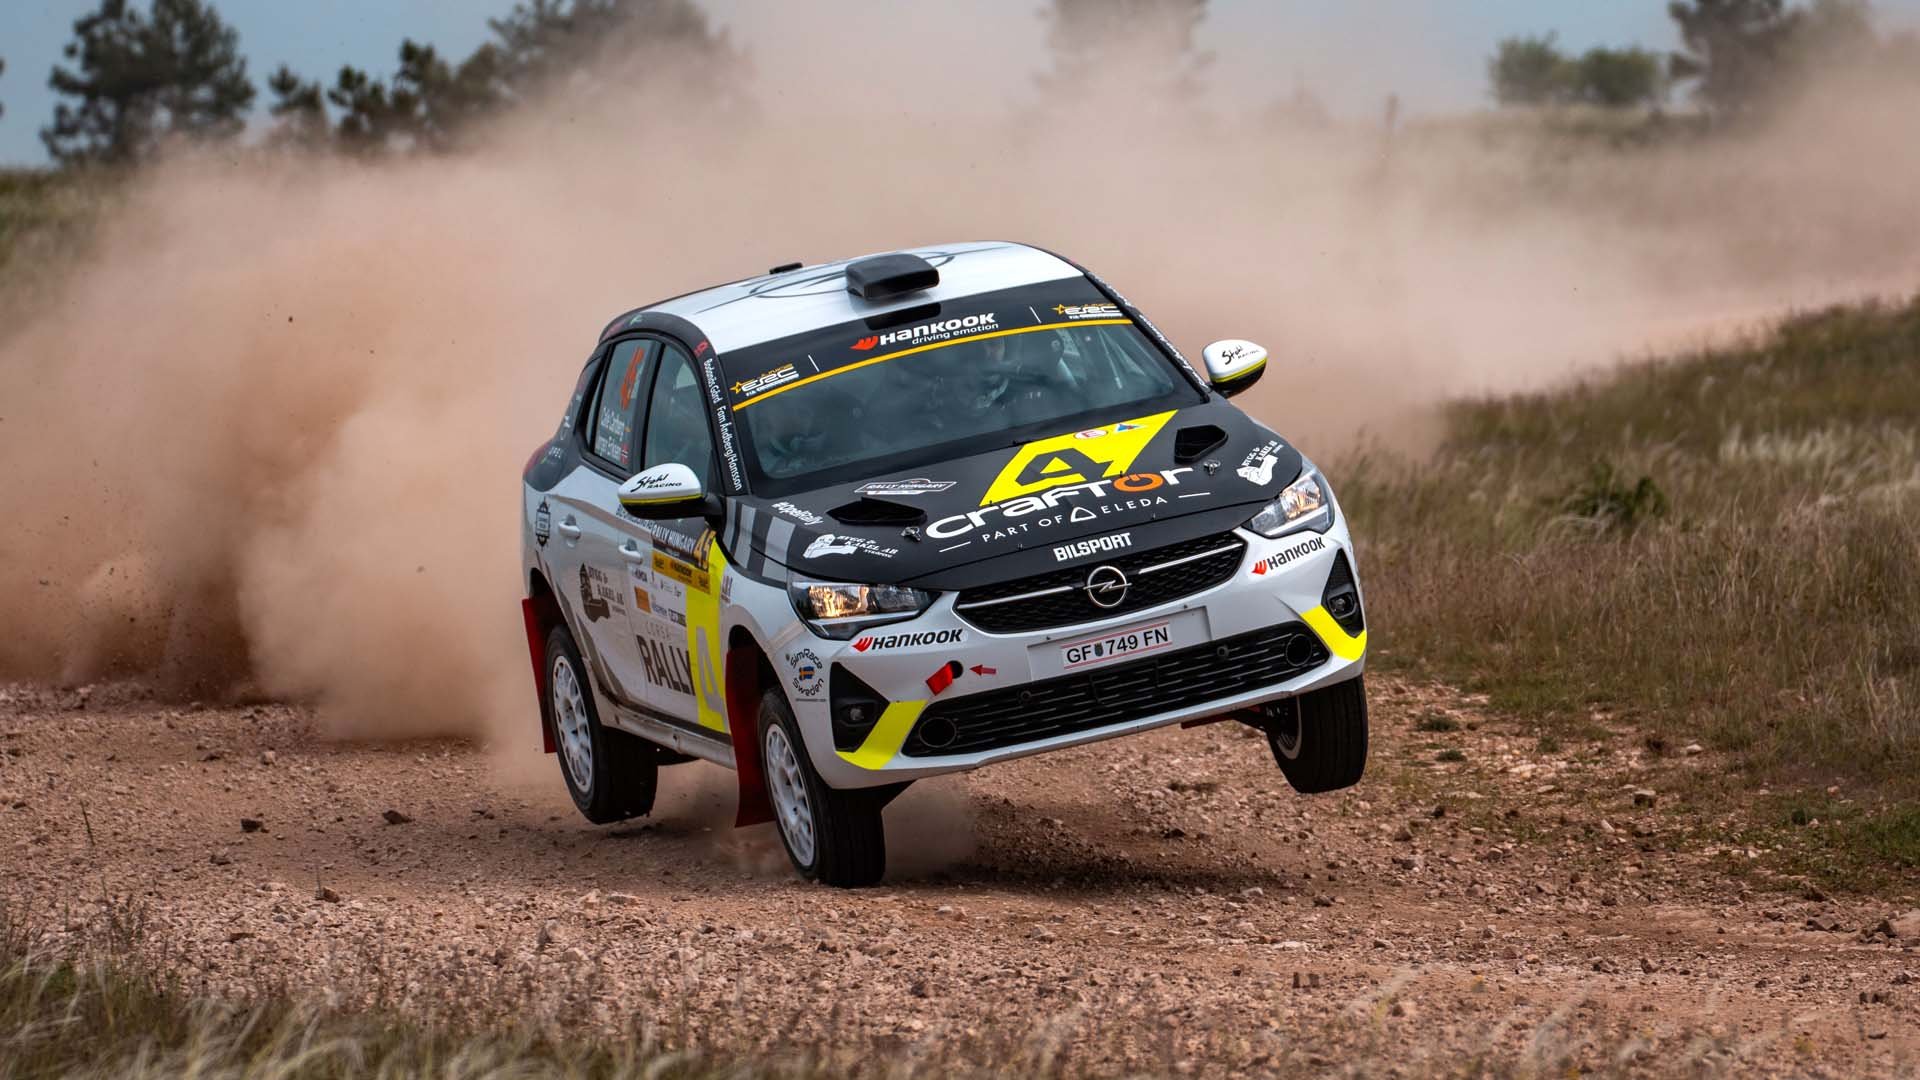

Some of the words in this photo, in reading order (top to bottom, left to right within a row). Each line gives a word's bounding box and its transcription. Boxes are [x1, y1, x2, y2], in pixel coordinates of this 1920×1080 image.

[880, 312, 996, 345] HANKOOK
[911, 331, 951, 346] driving
[952, 322, 999, 337] emotion
[982, 523, 1029, 543] PART
[1038, 514, 1064, 528] OF
[1101, 496, 1168, 515] ELEDA
[1053, 532, 1132, 562] BILSPORT
[1267, 536, 1326, 570] HANKOOK
[871, 628, 963, 651] HANKOOK
[1066, 644, 1092, 664] GF
[1105, 634, 1138, 655] 749
[1143, 626, 1169, 646] FN
[636, 634, 696, 696] RALLY
[791, 648, 823, 670] SimRace
[793, 678, 824, 697] Sweden
